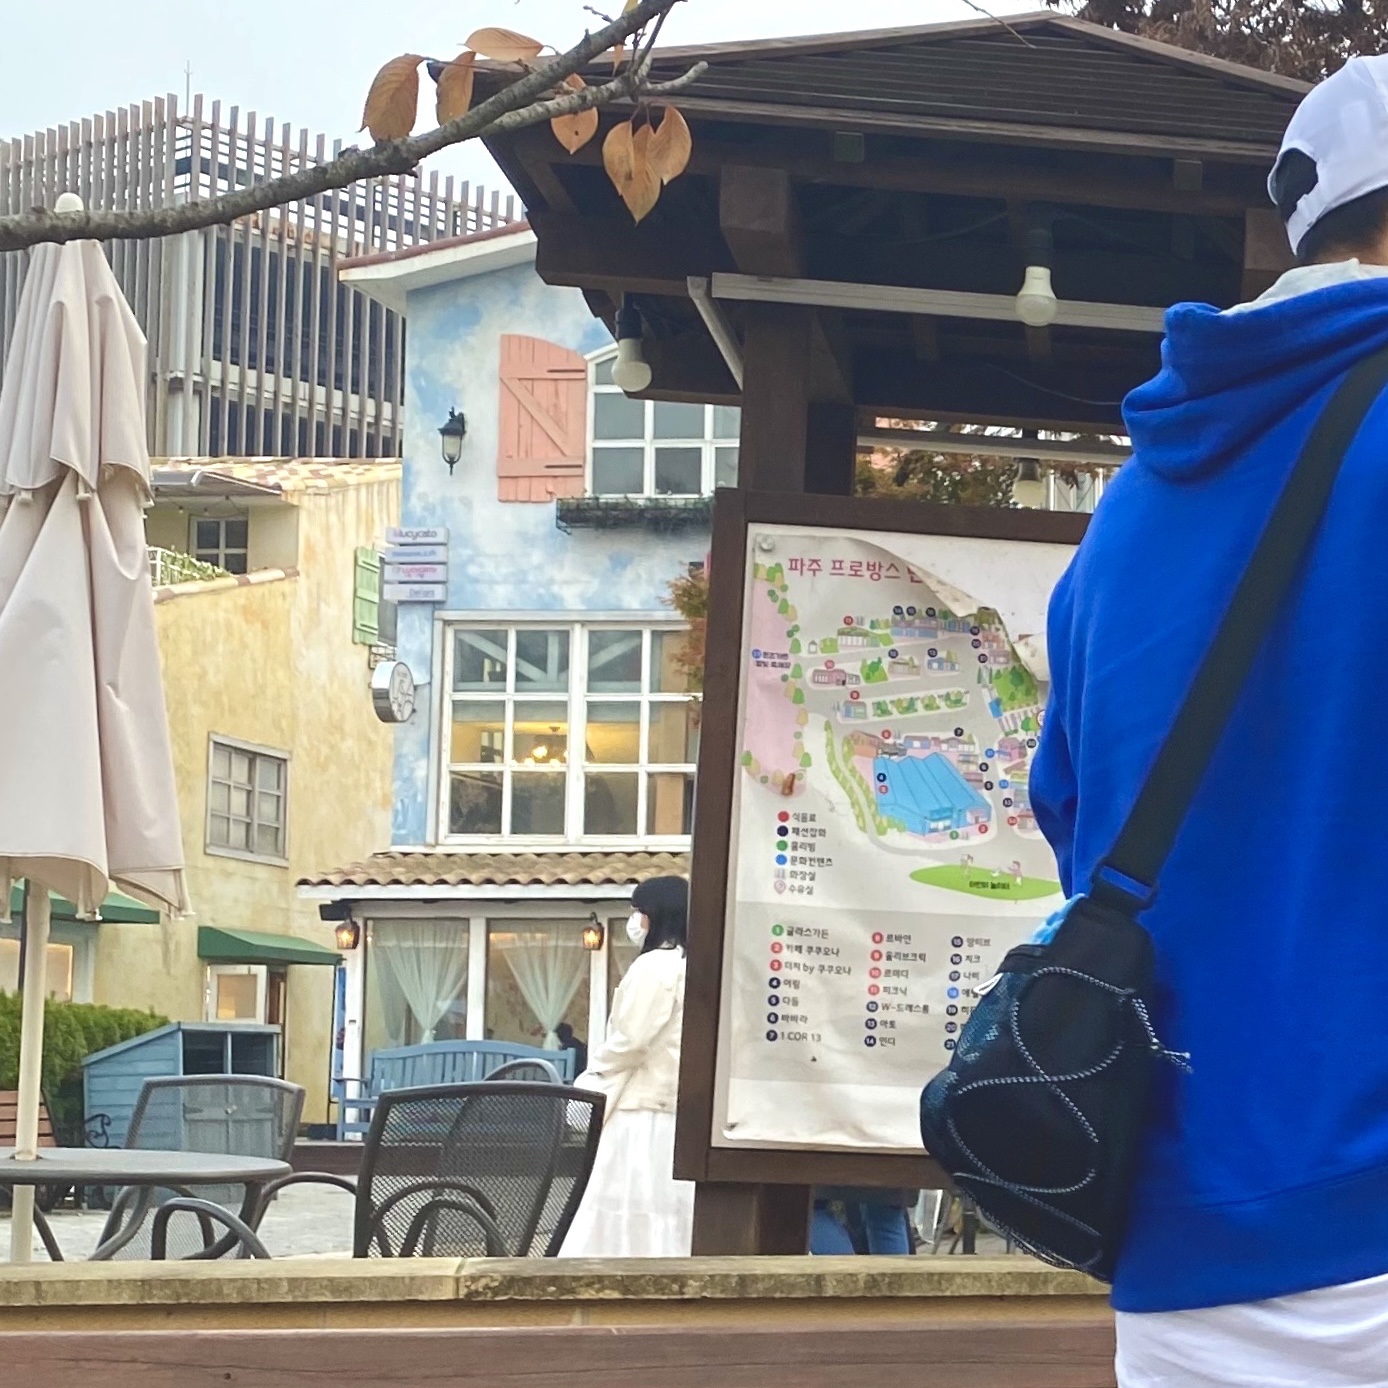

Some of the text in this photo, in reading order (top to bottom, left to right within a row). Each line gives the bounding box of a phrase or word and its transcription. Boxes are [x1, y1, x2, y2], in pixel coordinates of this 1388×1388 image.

[788, 557, 822, 577] 파주
[829, 559, 901, 582] 프로방스
[789, 870, 816, 881] 화장실
[802, 963, 815, 975] by
